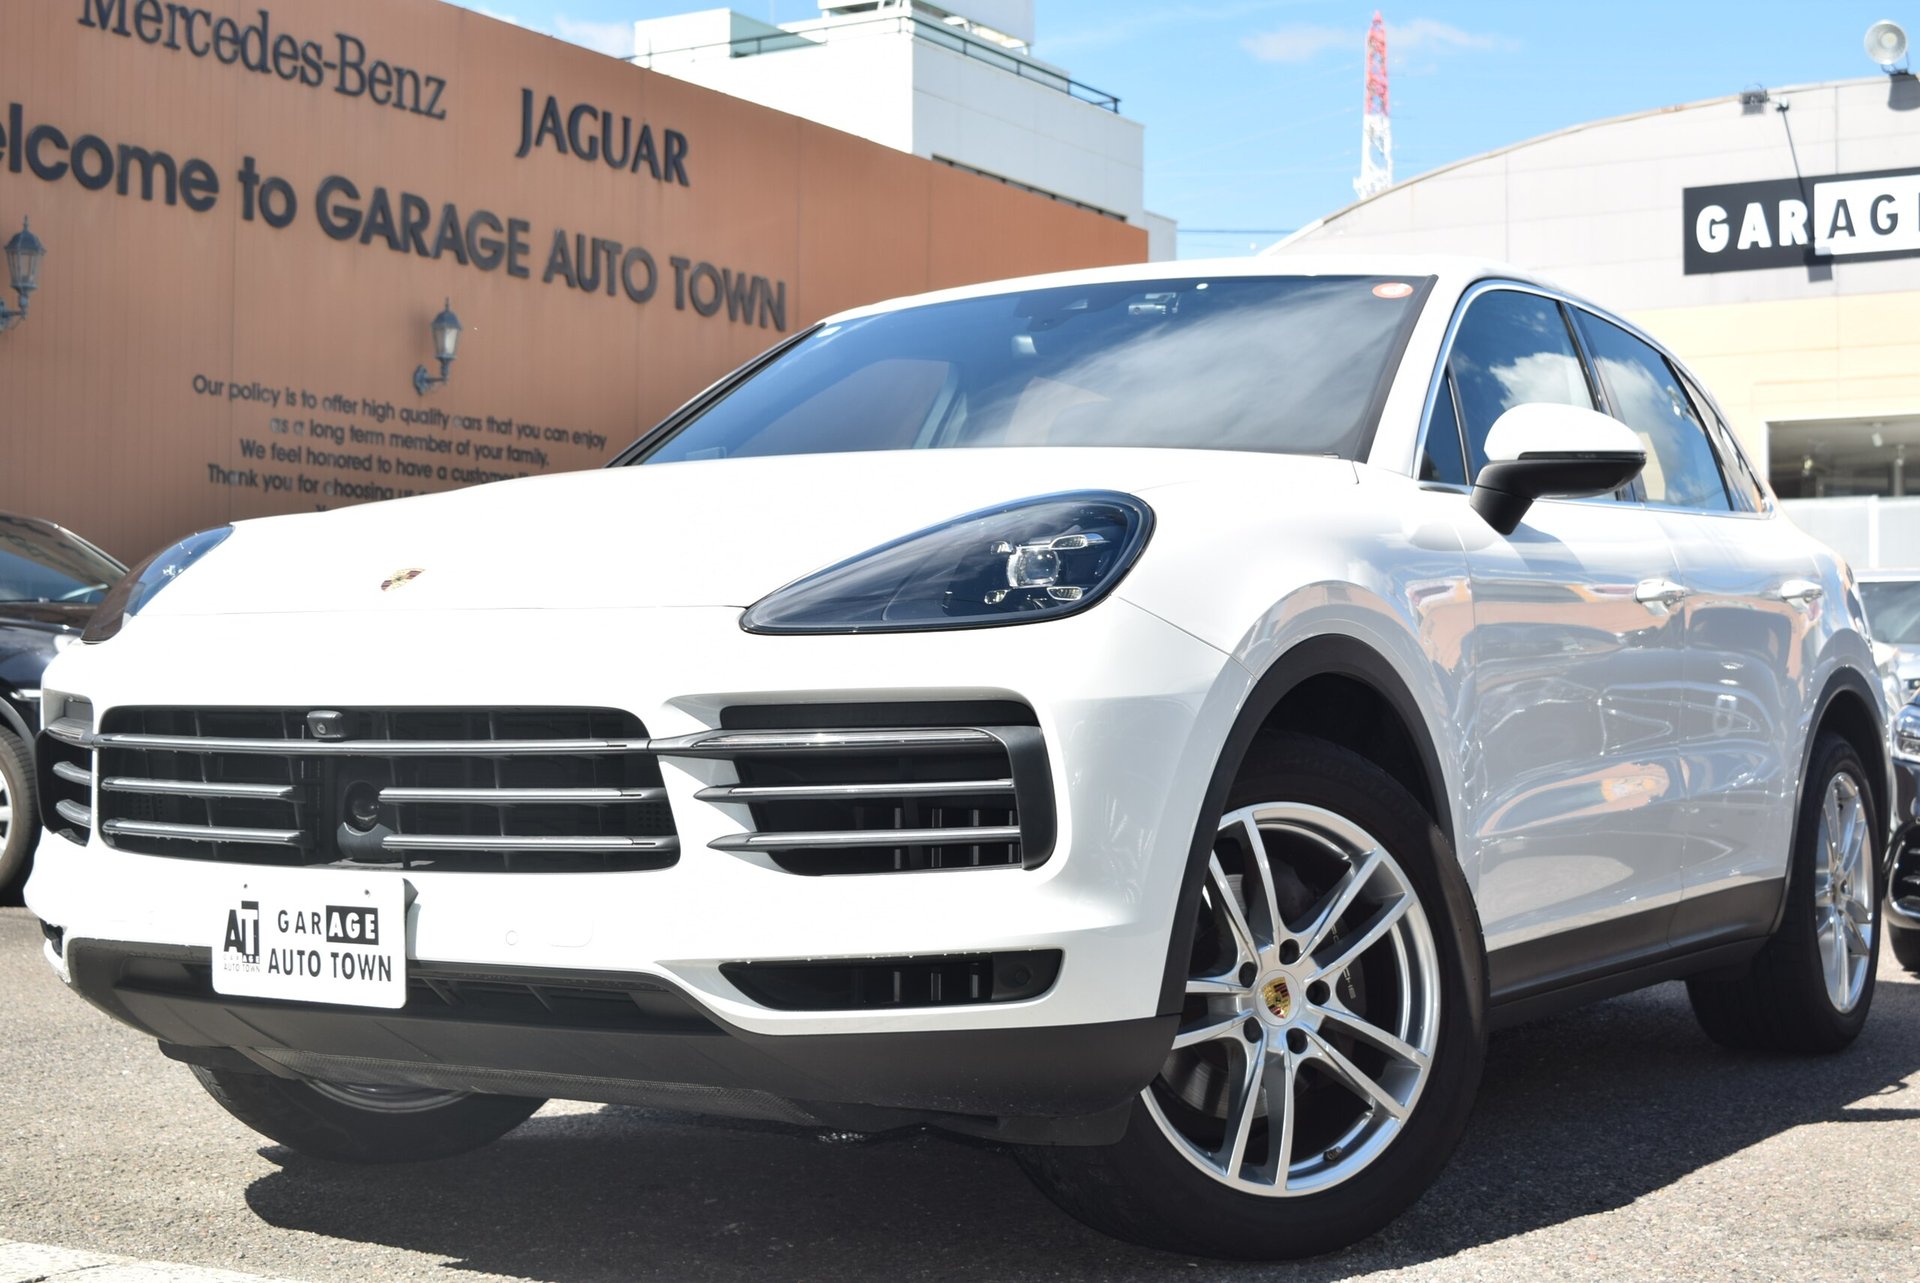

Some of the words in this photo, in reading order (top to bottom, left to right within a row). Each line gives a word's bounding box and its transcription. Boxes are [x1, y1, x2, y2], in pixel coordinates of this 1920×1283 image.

[78, 0, 447, 120] Mercedes-Benz
[515, 88, 690, 187] JAGUAR
[0, 102, 219, 212] lcome
[238, 156, 297, 228] to
[315, 174, 530, 280] GARAGE
[543, 228, 658, 304] AUTO
[670, 256, 787, 332] TOWN
[1696, 191, 1920, 253] GARAG
[193, 374, 223, 396] Our
[229, 382, 280, 407] policy
[286, 387, 296, 406] is
[301, 390, 317, 408] to
[323, 394, 357, 415] offer
[362, 398, 395, 423] high
[400, 406, 449, 428] quality
[486, 415, 513, 435] that
[516, 422, 541, 441] you
[544, 426, 569, 443] can
[573, 430, 607, 451] enjoy
[240, 438, 266, 459] We
[271, 443, 301, 463] feel
[306, 447, 372, 472] honored
[377, 456, 392, 475] to
[396, 458, 433, 478] have
[437, 466, 448, 480] a
[310, 419, 344, 445] long
[350, 426, 384, 445] term
[389, 431, 452, 454] member
[456, 438, 472, 455] of
[474, 444, 504, 462] your
[208, 463, 257, 487] Thank
[262, 474, 293, 493] you
[299, 473, 319, 494] for
[324, 478, 394, 501] choosing
[278, 909, 376, 939] GARAGE
[268, 948, 322, 977] AUTO
[331, 952, 392, 982] TOWN
